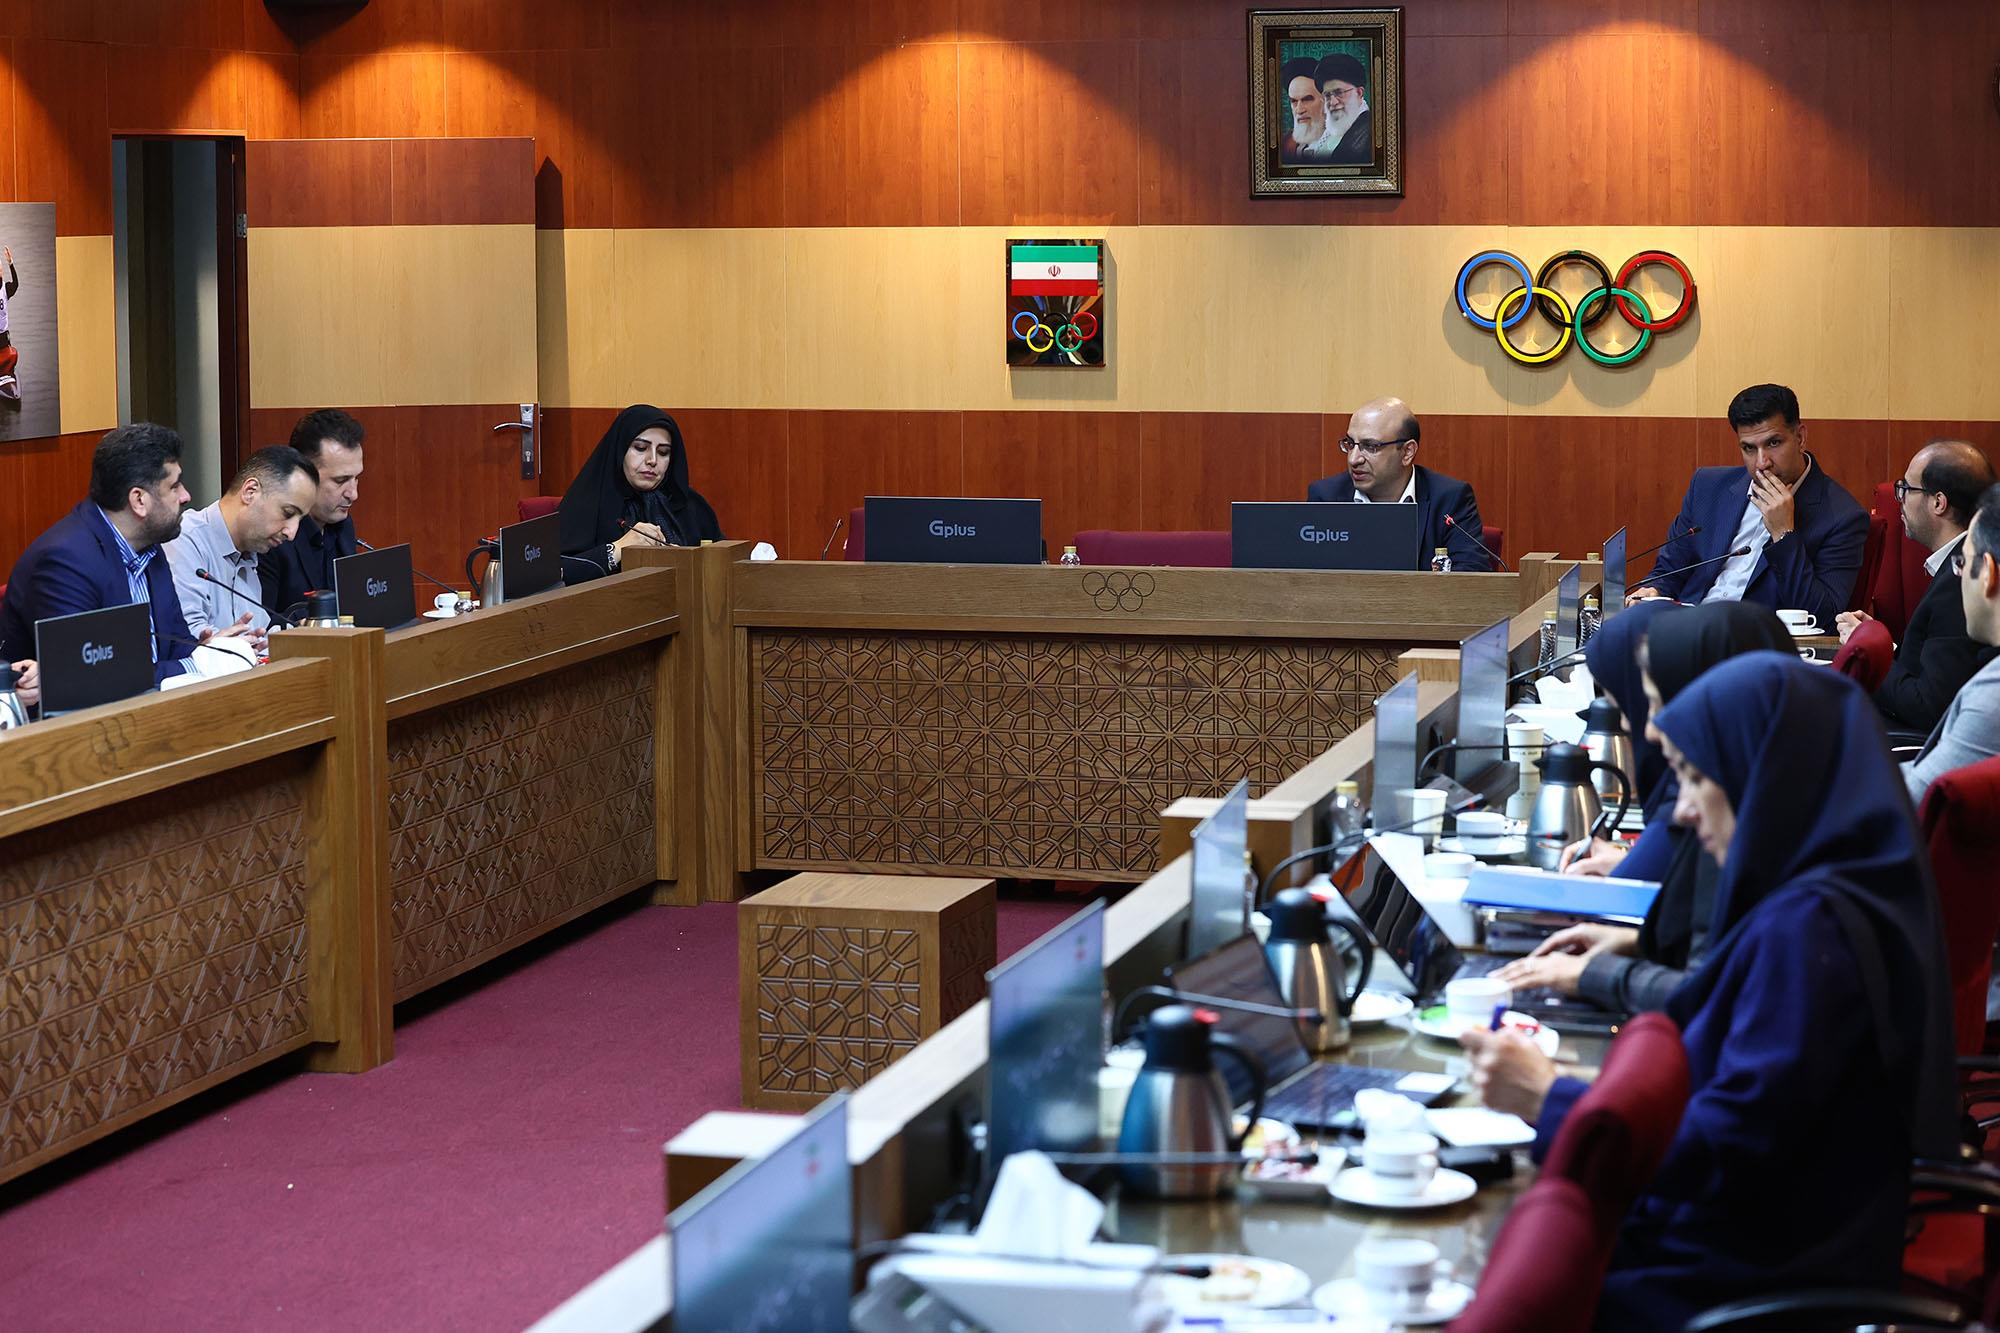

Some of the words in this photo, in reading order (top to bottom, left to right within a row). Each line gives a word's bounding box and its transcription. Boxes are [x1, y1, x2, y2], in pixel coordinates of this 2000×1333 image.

[929, 520, 976, 538] Gplus
[1300, 525, 1349, 543] Gplus
[367, 577, 387, 597] Gplus
[82, 641, 113, 666] Gplus
